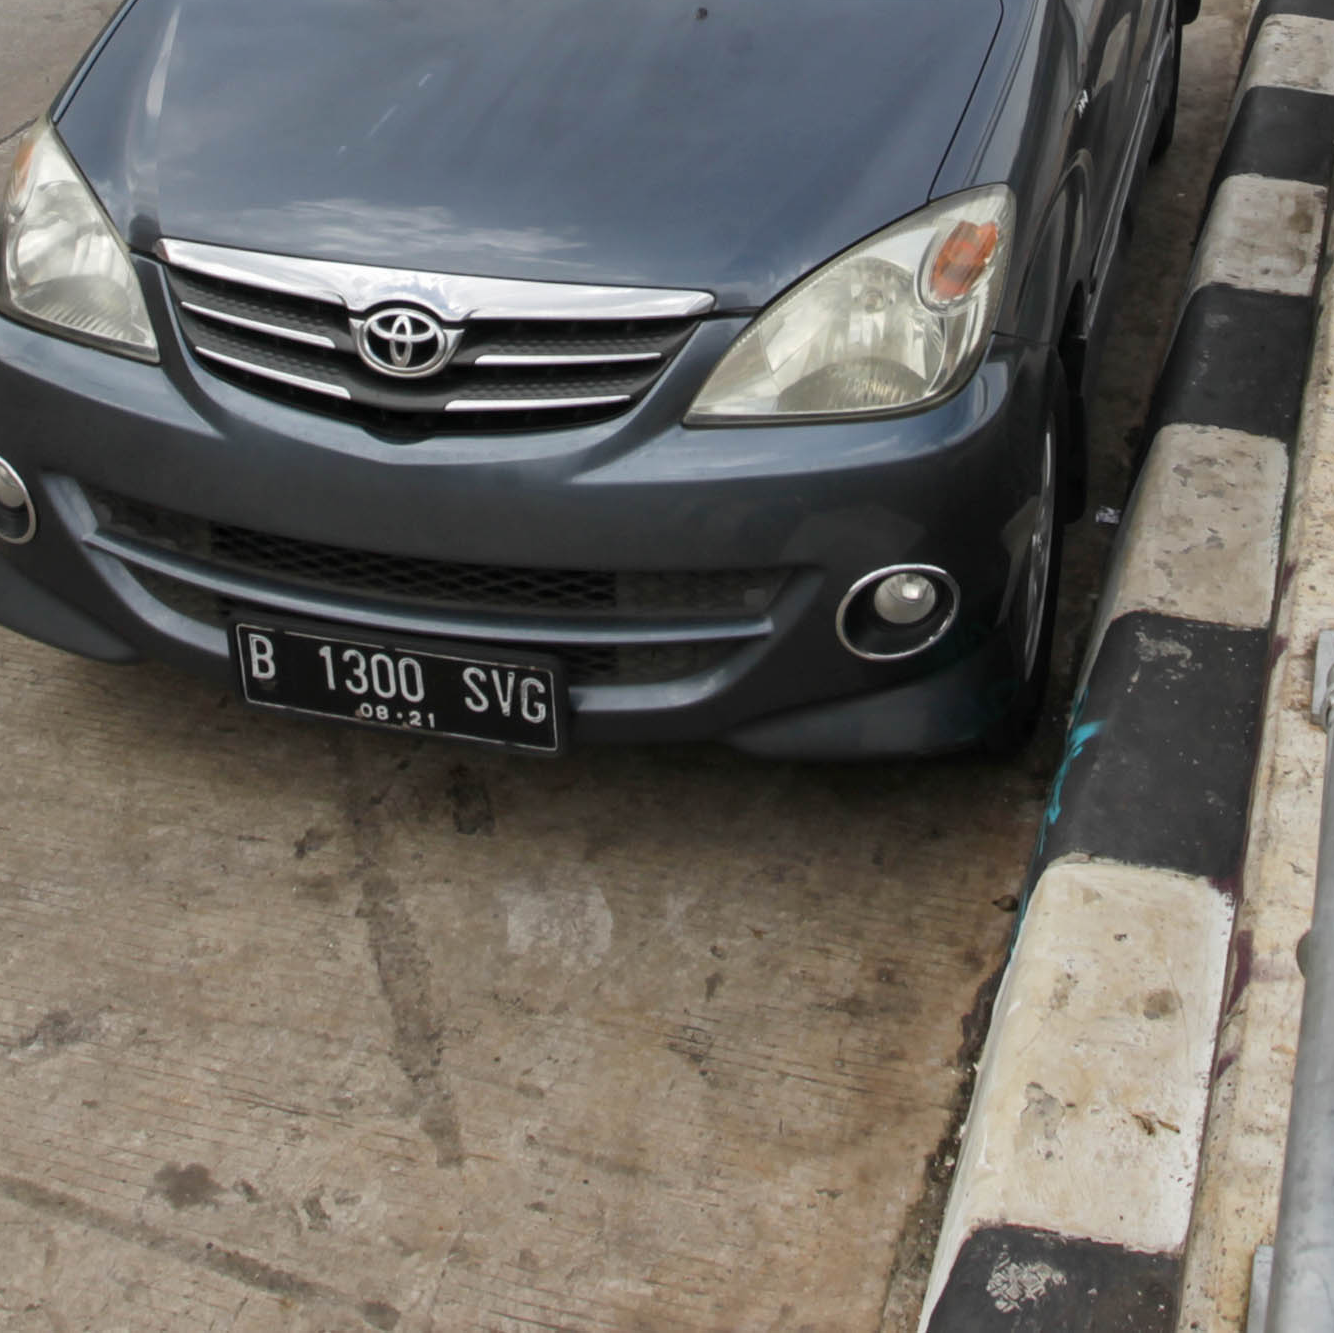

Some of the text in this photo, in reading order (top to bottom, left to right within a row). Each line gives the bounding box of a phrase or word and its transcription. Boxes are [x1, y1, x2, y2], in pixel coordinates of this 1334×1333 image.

[247, 633, 547, 724] B 1300 SVG
